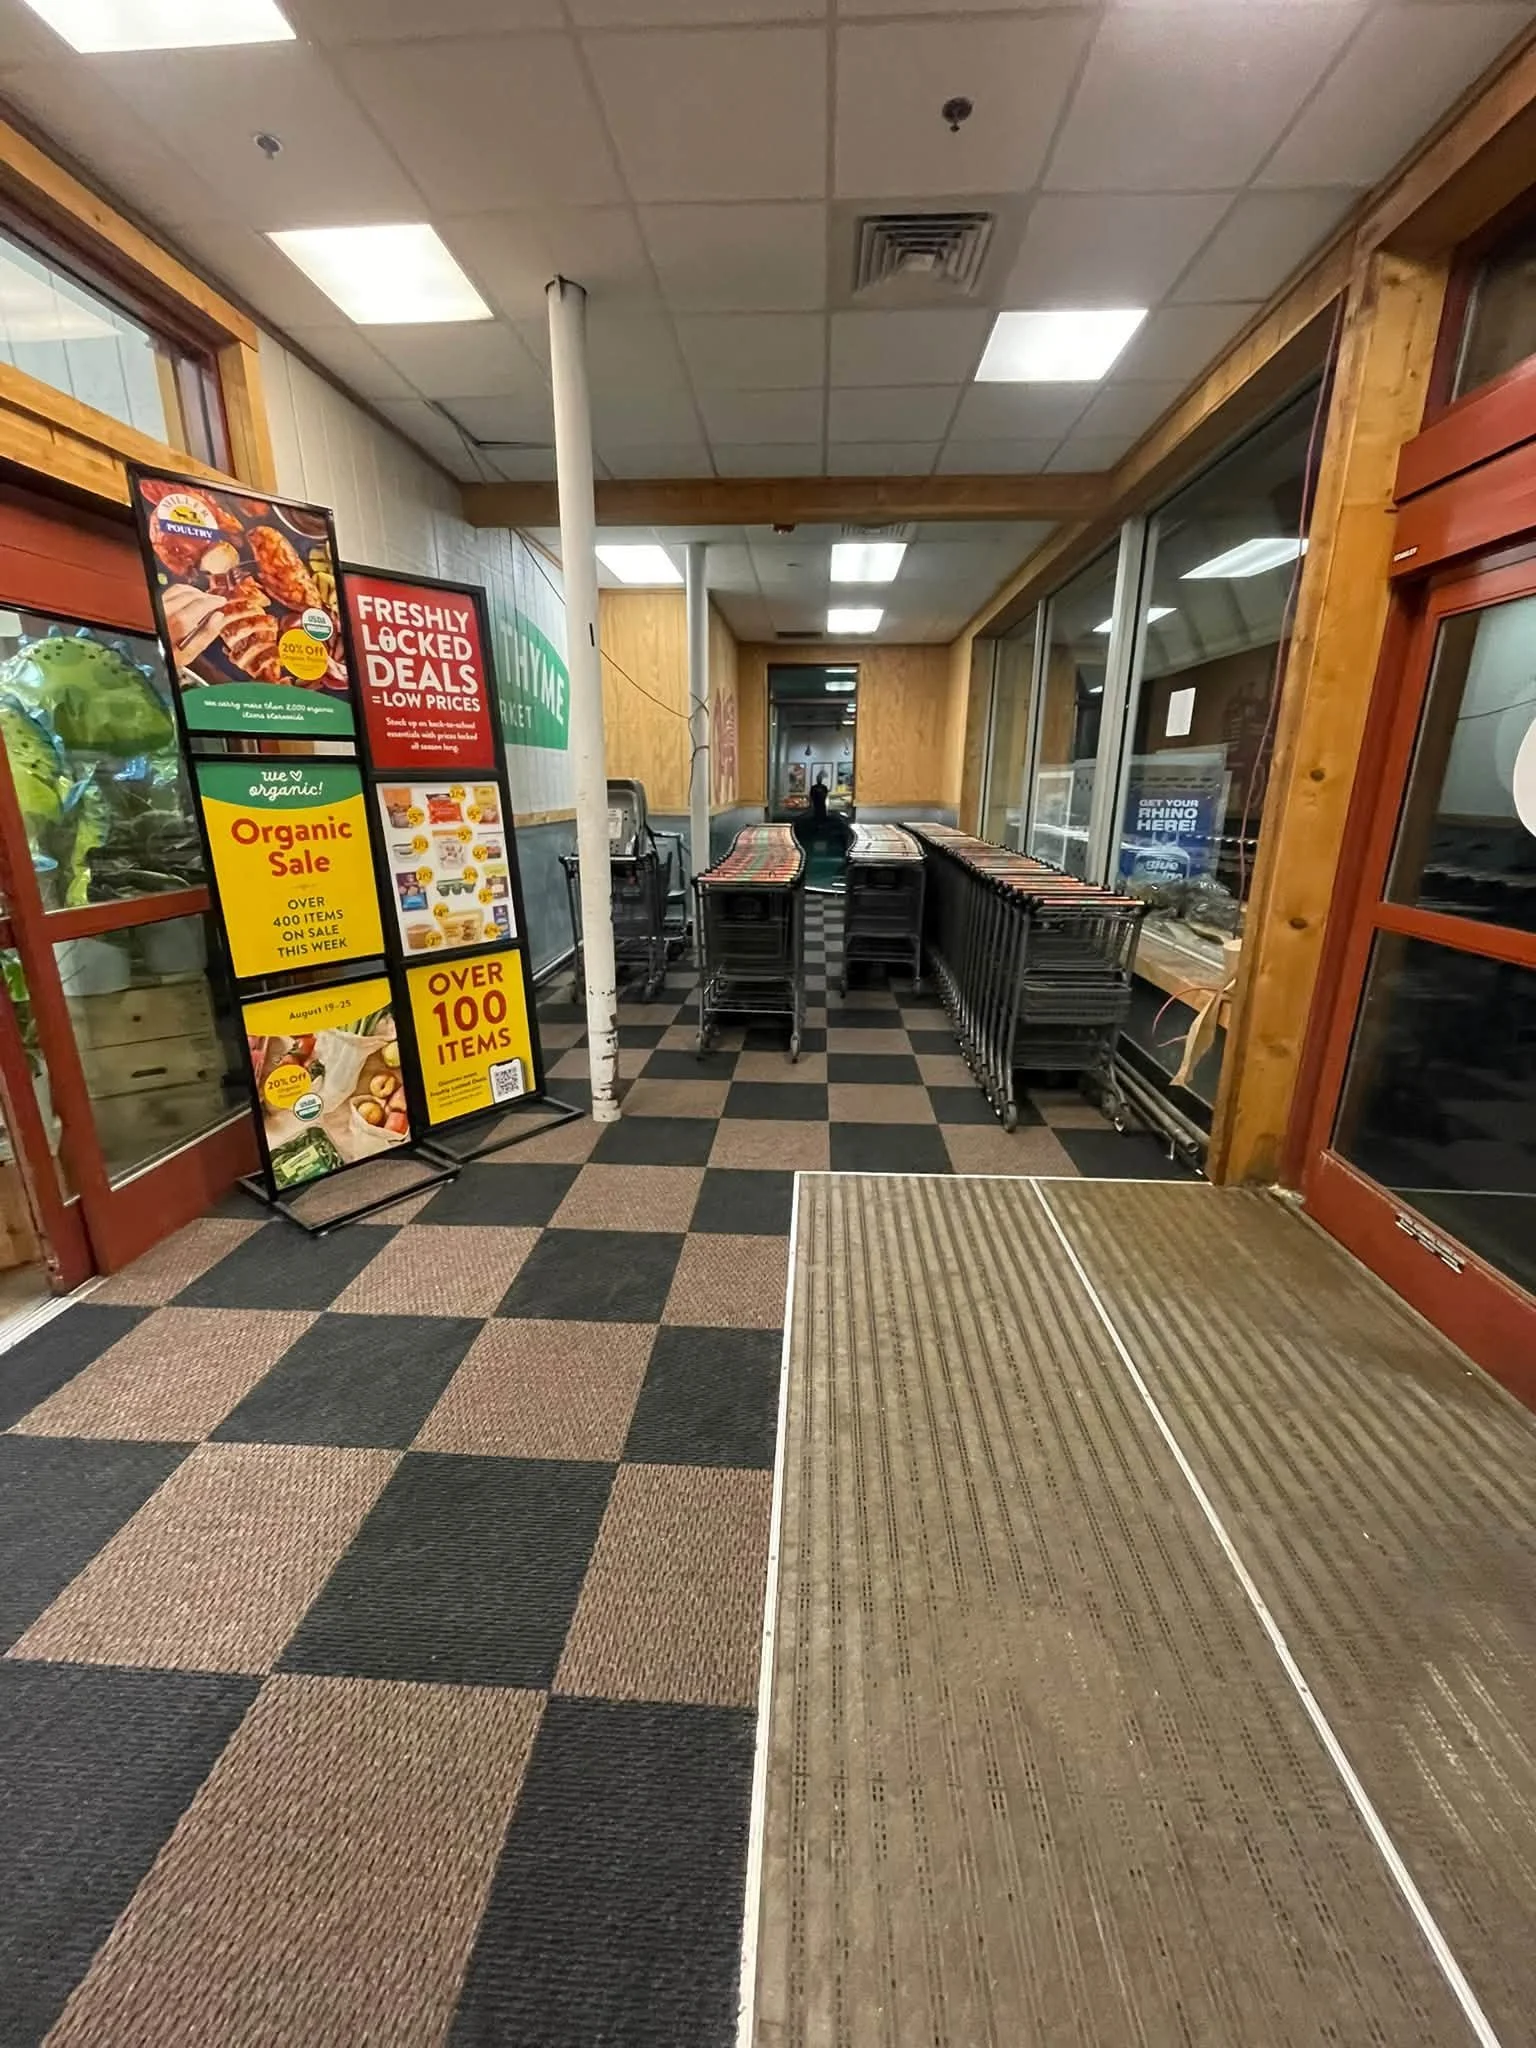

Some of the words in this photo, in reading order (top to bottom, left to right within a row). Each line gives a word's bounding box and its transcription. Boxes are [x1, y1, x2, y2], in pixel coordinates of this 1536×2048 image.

[166, 523, 213, 538] POULTRY
[357, 594, 469, 634] FRESHLY
[282, 642, 303, 654] 20%
[305, 645, 324, 657] Off
[365, 654, 479, 695] DEALS
[499, 623, 565, 726] THYME
[426, 694, 481, 712] PRICES
[499, 698, 532, 729] RKET
[385, 717, 407, 726] Stock
[408, 721, 418, 729] up
[421, 731, 436, 739] with
[457, 732, 478, 740] locked
[411, 742, 419, 750] all
[420, 743, 442, 751] season
[261, 770, 288, 782] we
[249, 782, 323, 802] organic!
[1139, 799, 1164, 807] GET
[1166, 799, 1200, 807] YOUR
[1138, 807, 1198, 819] RHINO
[231, 815, 353, 851] Organic
[1136, 819, 1197, 832] HERE!
[268, 849, 331, 878] Sale
[1146, 860, 1179, 871] Blue
[287, 896, 325, 910] OVER
[273, 916, 300, 928] 400
[304, 909, 344, 923] ITEMS
[282, 930, 304, 942] ON
[308, 924, 340, 938] SALE
[277, 944, 308, 959] THIS
[312, 937, 348, 952] WEEK
[428, 961, 503, 996] OVER
[289, 1006, 323, 1021] August
[432, 989, 507, 1037] 100
[437, 1027, 512, 1065] ITEMS
[267, 1077, 289, 1090] 20%
[289, 1071, 307, 1084] Off
